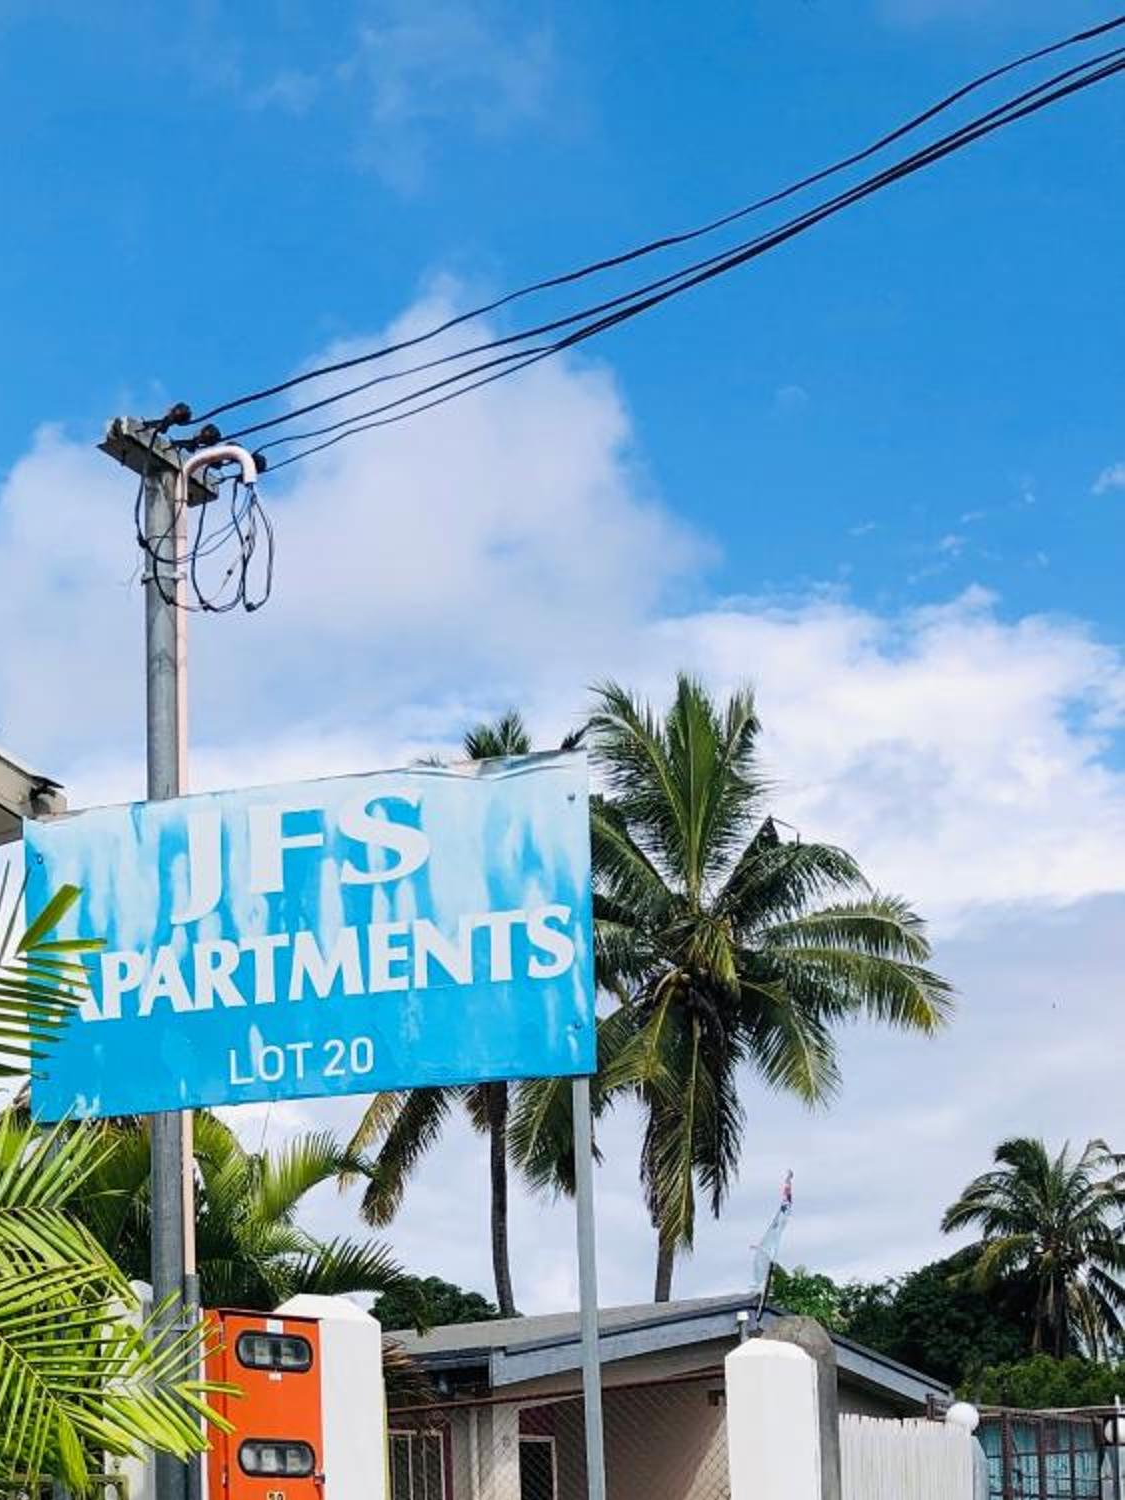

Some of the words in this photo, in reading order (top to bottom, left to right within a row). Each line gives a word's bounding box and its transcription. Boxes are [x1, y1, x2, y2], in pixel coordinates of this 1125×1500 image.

[171, 794, 430, 925] JFS
[49, 903, 576, 1023] APARTMENTS
[229, 1042, 312, 1086] LOT
[324, 1036, 374, 1076] 20
